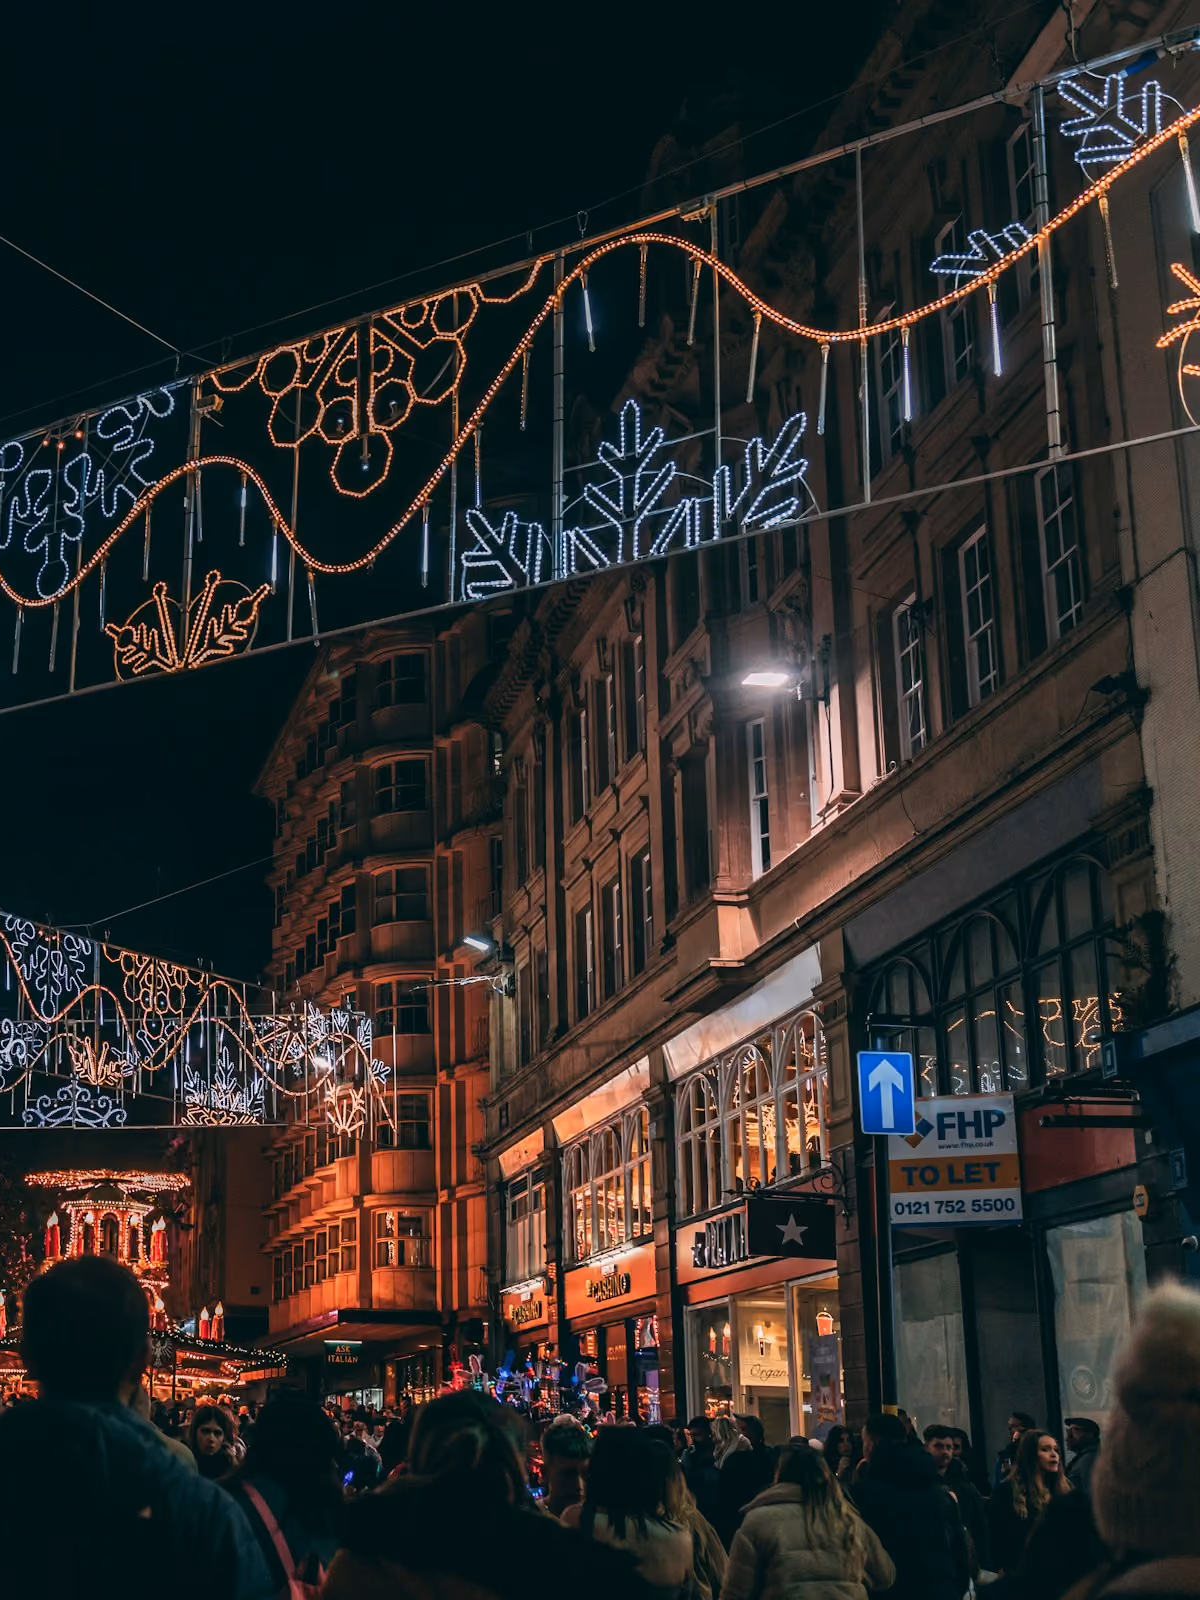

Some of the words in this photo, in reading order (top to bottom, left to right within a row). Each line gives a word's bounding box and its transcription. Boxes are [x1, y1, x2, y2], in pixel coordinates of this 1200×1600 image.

[936, 1109, 1006, 1141] FHP
[938, 1141, 994, 1150] www.fhp.co.uk
[901, 1165, 940, 1187] TO
[947, 1161, 1001, 1185] LET
[894, 1201, 931, 1216] 0121
[935, 1200, 966, 1214] 752
[971, 1198, 1016, 1213] 5500
[336, 1345, 351, 1353] ASK
[327, 1354, 358, 1364] ITALIAN
